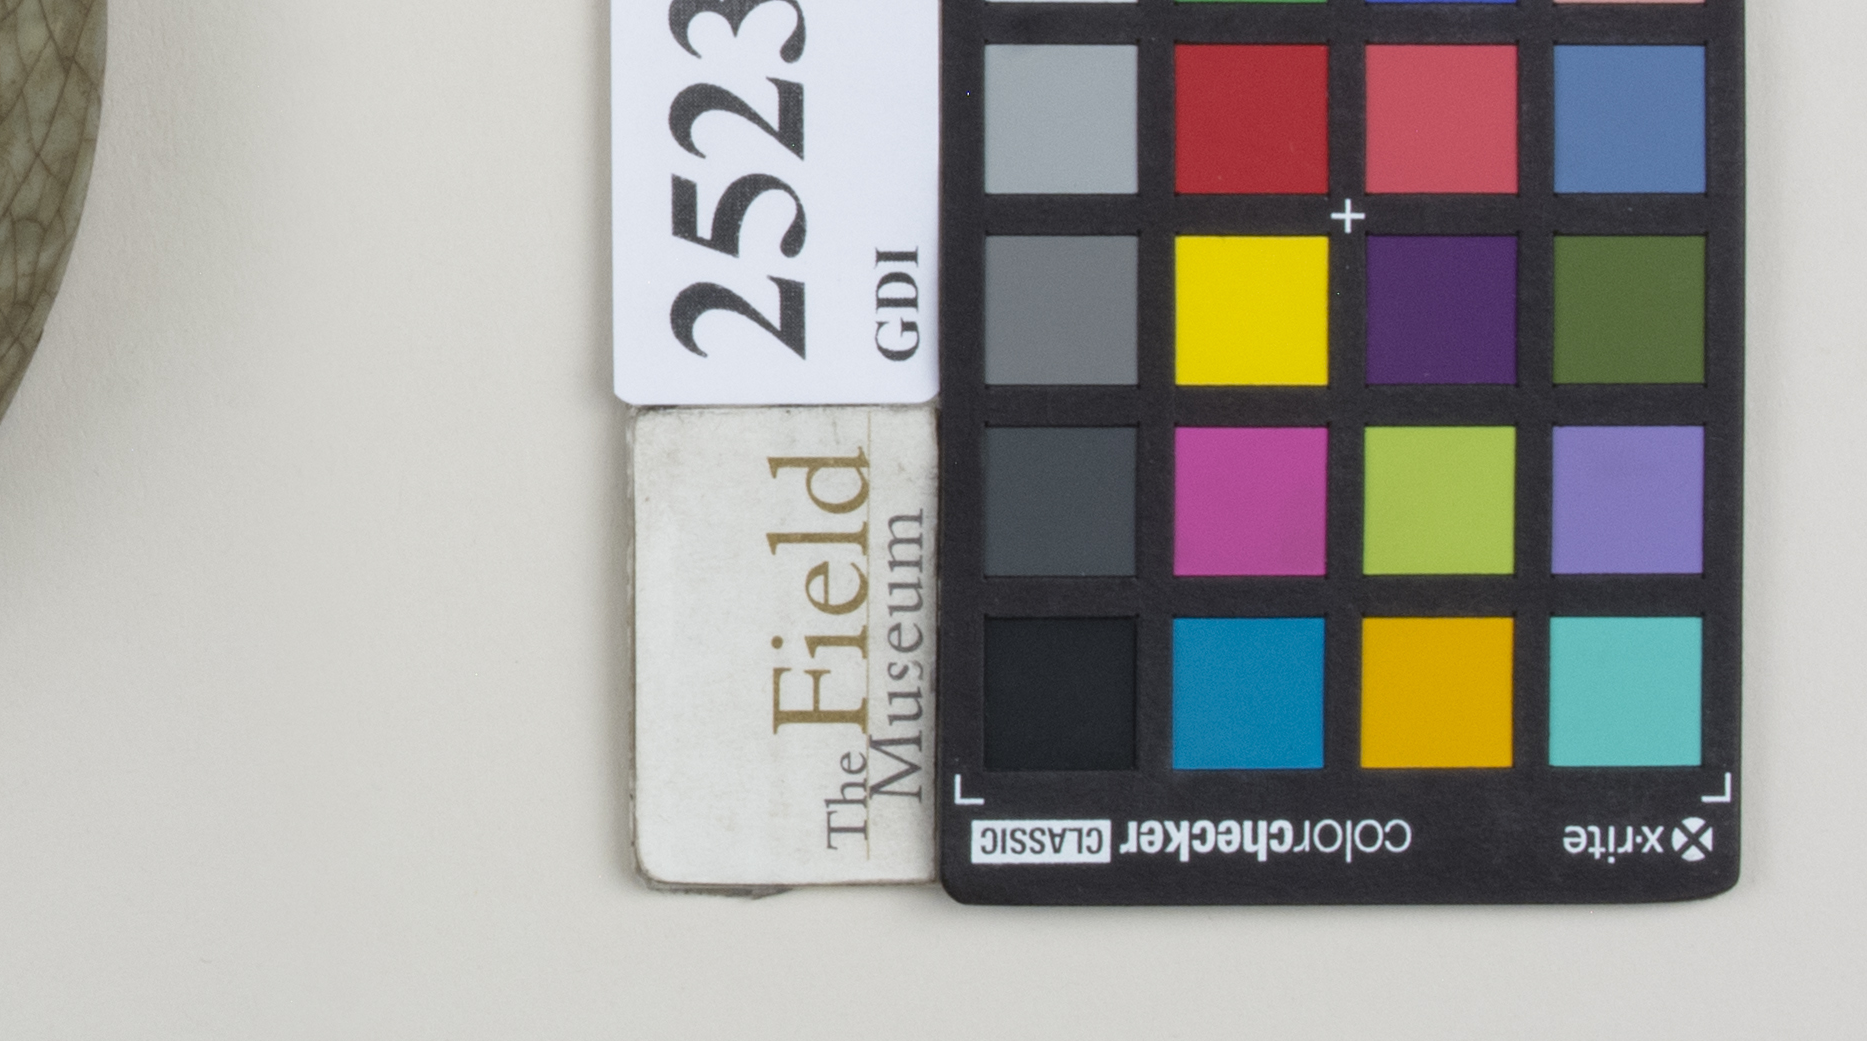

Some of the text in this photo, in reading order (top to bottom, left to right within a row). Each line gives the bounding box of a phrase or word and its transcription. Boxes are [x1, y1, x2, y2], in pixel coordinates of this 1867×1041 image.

[874, 246, 920, 362] GDI
[766, 446, 871, 850] The Field
[868, 508, 923, 804] Museum
[980, 818, 1413, 864] colorchecker CLASSIC
